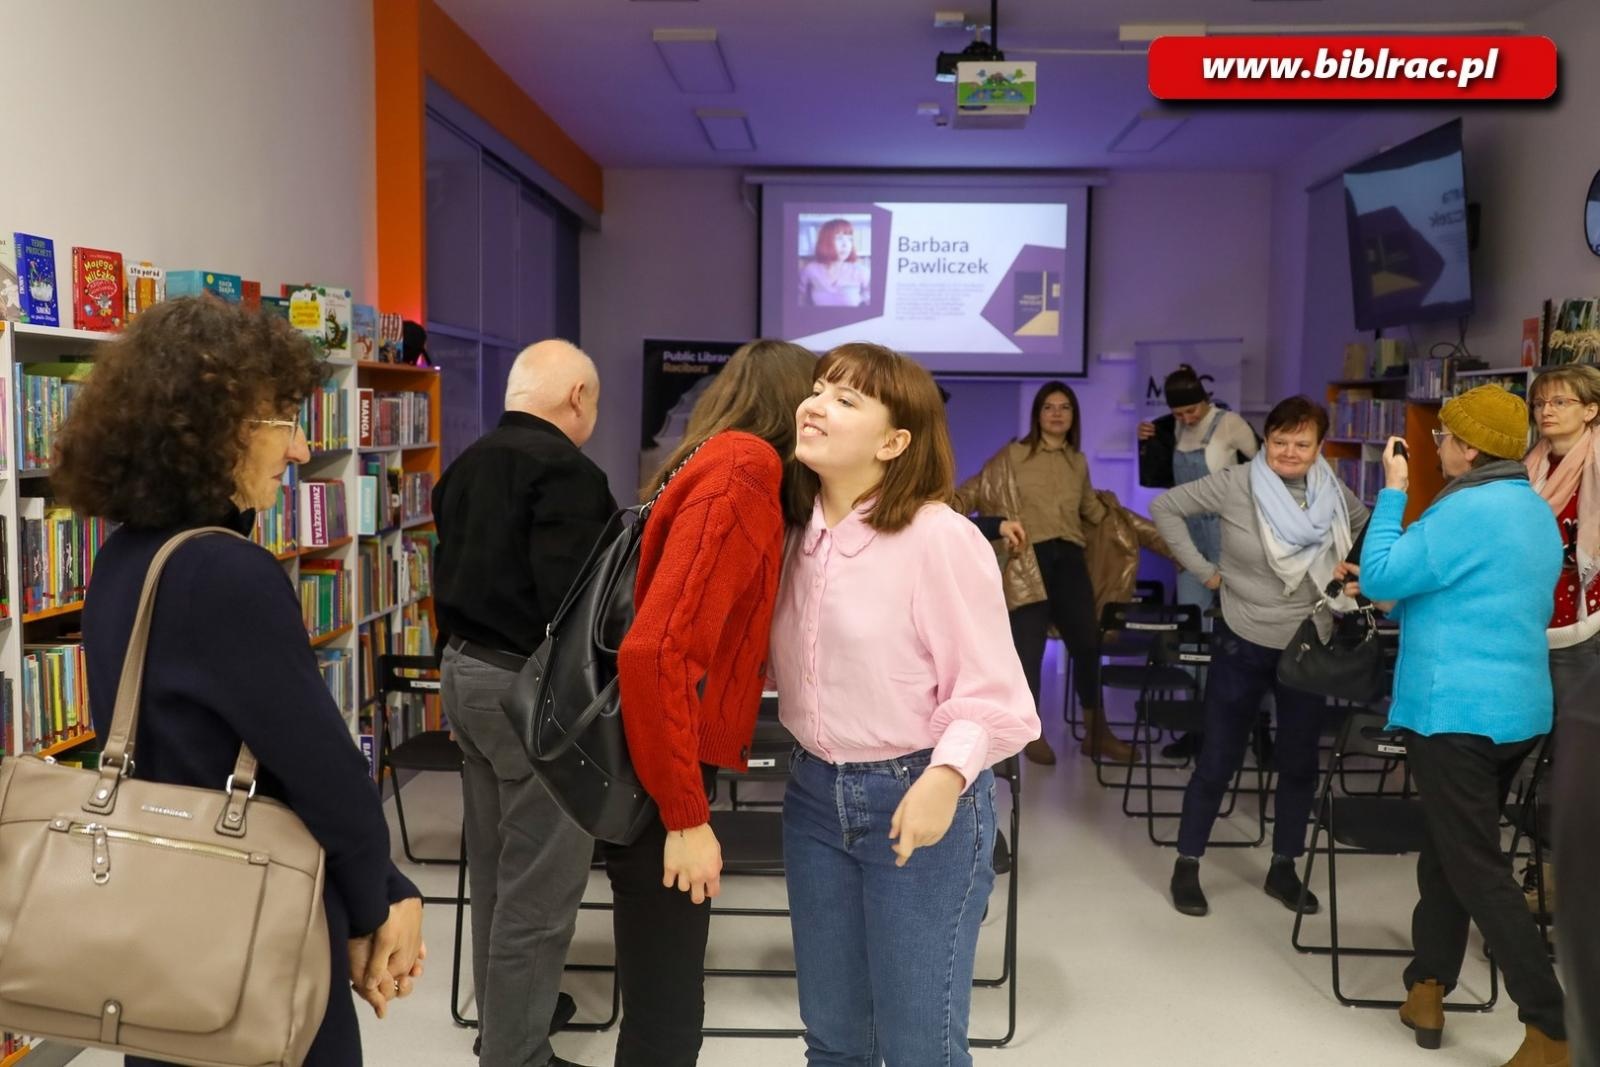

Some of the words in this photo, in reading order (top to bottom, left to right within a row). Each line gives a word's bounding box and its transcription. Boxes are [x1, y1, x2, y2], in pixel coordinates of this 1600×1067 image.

[898, 236, 970, 253] Barbara
[897, 257, 989, 275] Pawliczek
[663, 350, 696, 362] Public
[1146, 374, 1215, 399] MC
[361, 399, 370, 438] MANGA
